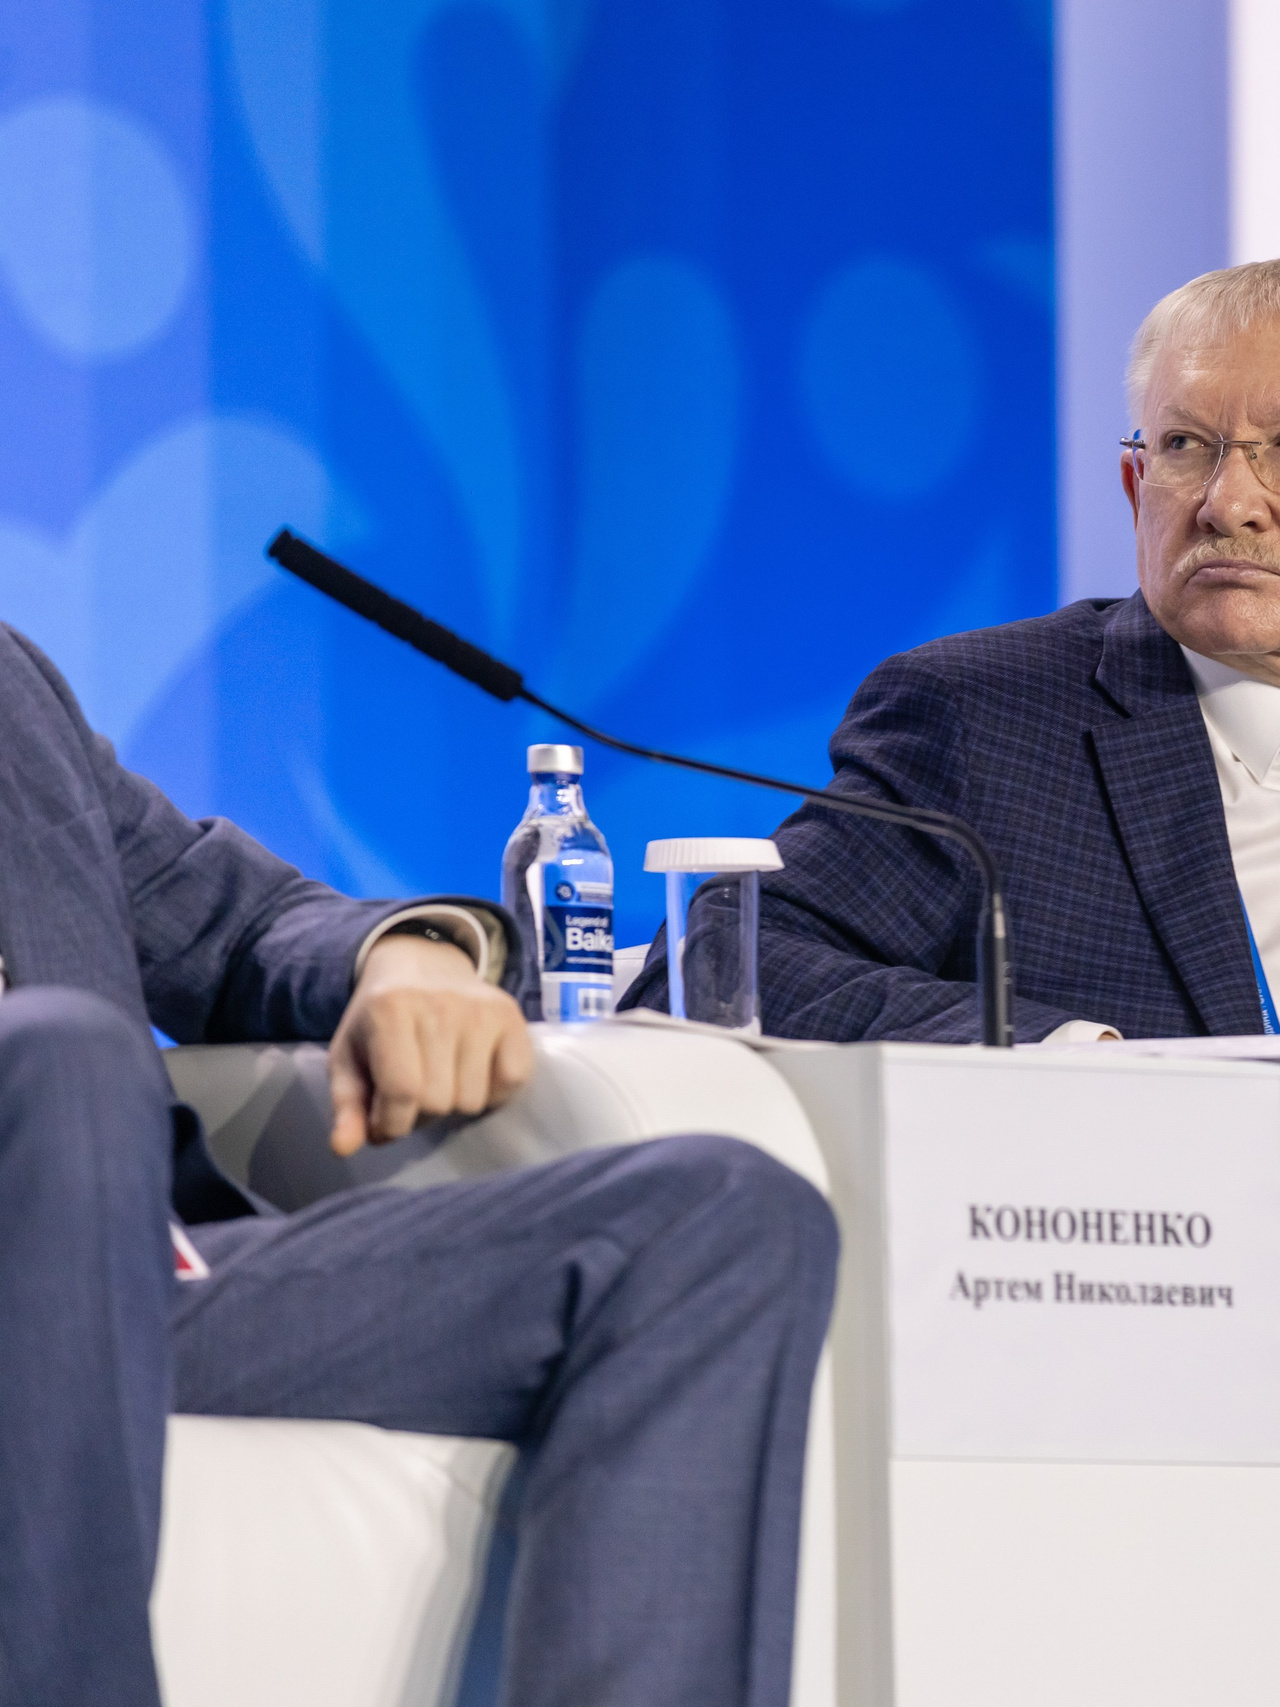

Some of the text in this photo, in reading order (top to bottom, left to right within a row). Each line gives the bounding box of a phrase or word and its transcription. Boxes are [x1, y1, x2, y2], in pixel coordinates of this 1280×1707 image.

[967, 1203, 1213, 1248] КОНОНЕНКО
[952, 1269, 1235, 1310] Артем Николаевич
